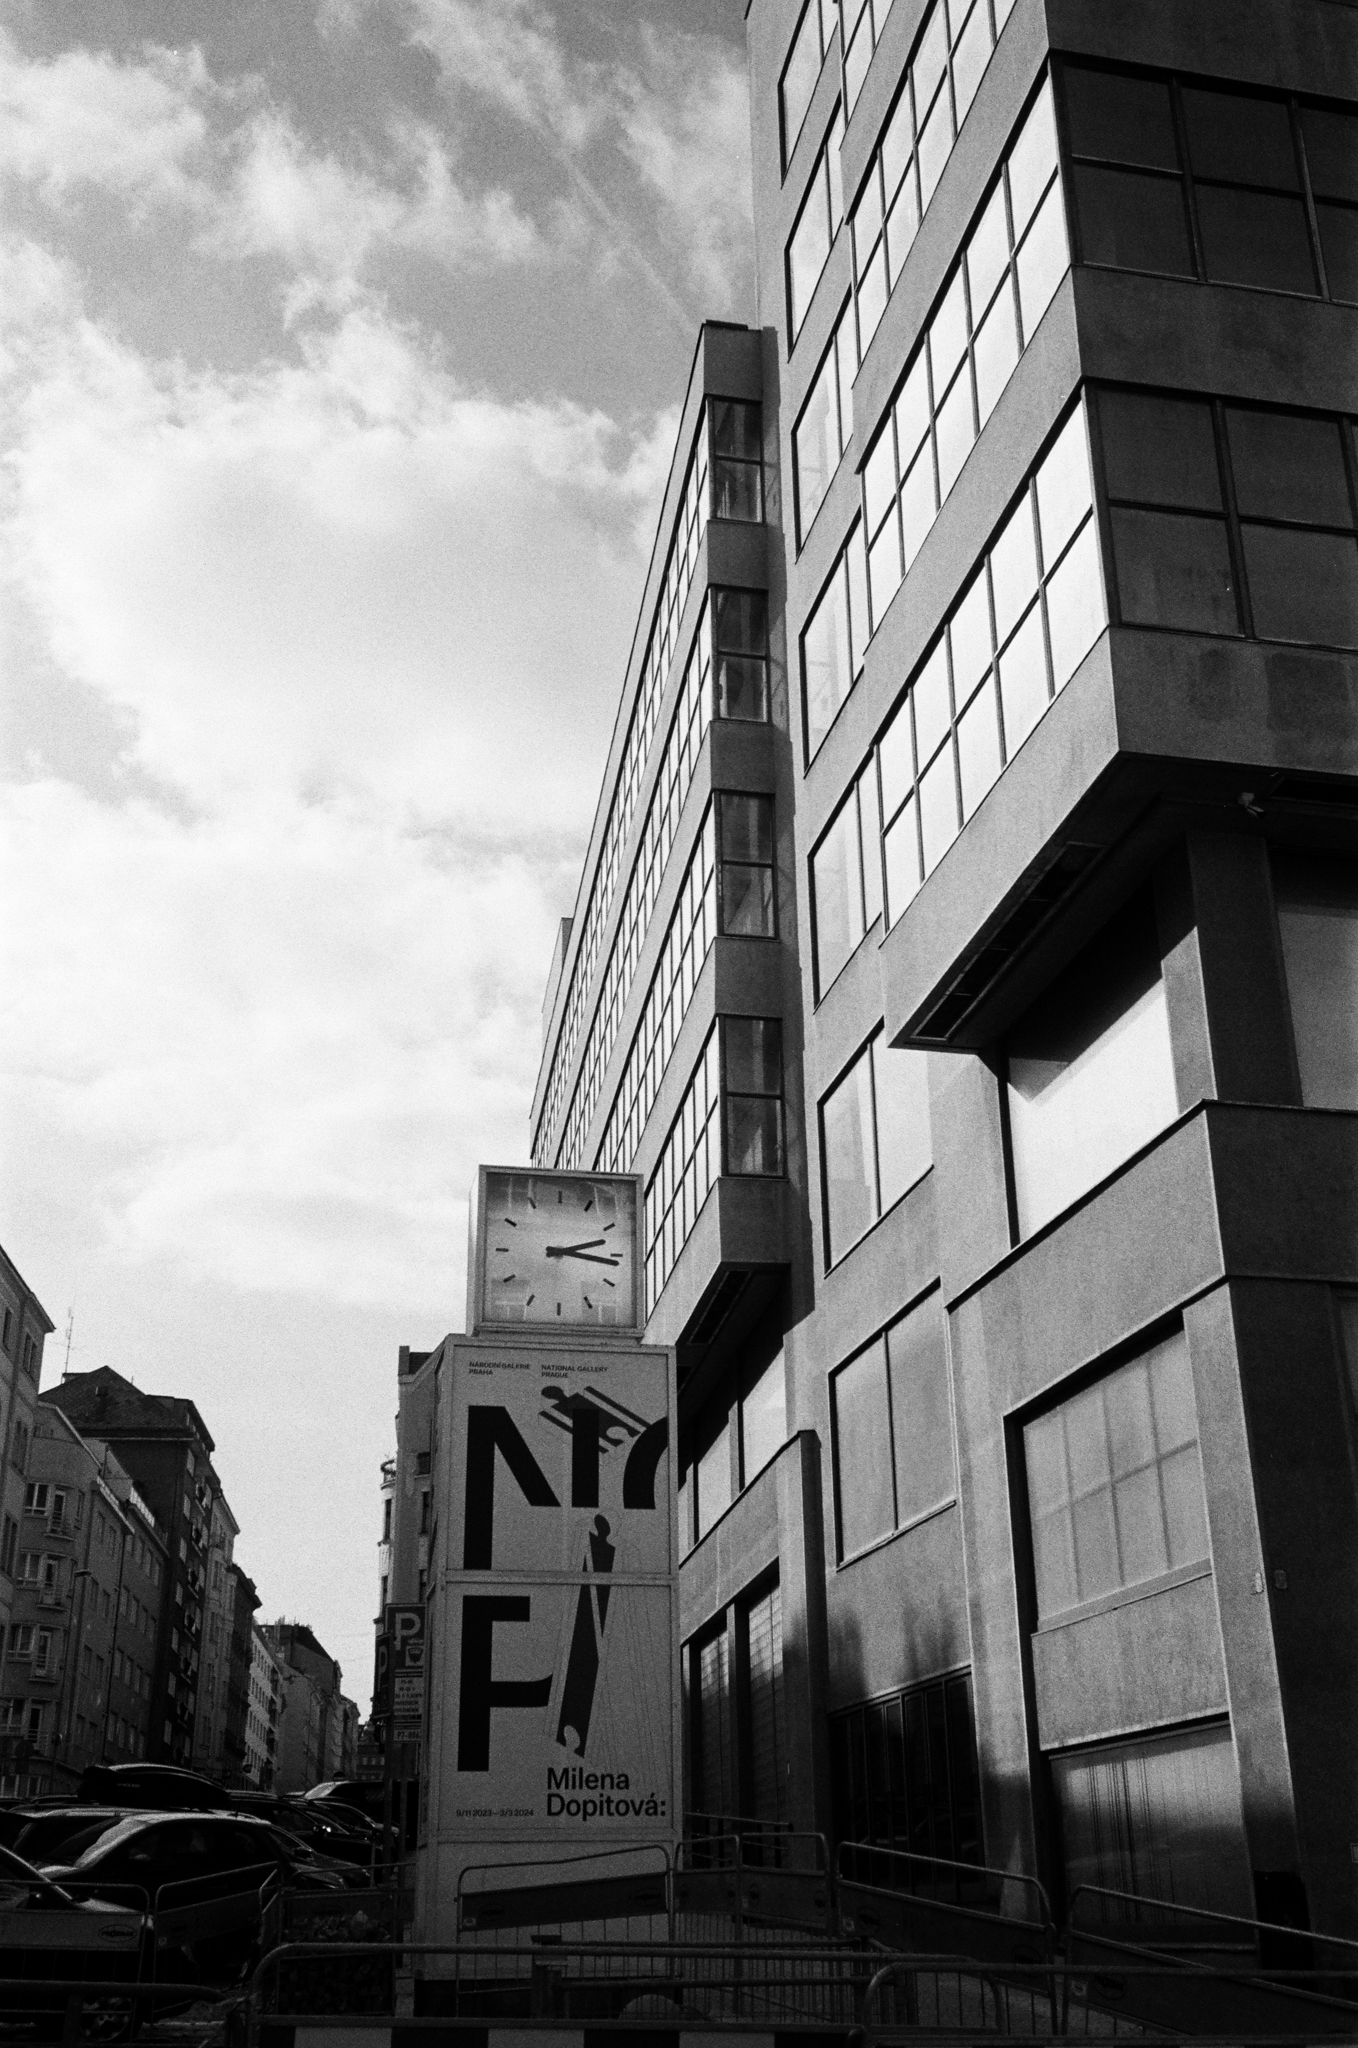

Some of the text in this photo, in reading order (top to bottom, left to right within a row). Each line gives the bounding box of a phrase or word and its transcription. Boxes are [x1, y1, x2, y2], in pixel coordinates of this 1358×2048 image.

[469, 1361, 501, 1369] NÁRODNÍ
[541, 1364, 608, 1373] NATIONAL GALLERY
[468, 1368, 494, 1376] PRAHA
[541, 1371, 569, 1379] PRAGUE
[394, 1612, 421, 1651] P
[547, 1767, 630, 1791] Milena
[546, 1792, 667, 1822] Dopitová:
[456, 1809, 471, 1818] 9/11
[472, 1809, 492, 1817] 2023
[500, 1808, 513, 1817] 3/3
[514, 1809, 534, 1817] 2024
